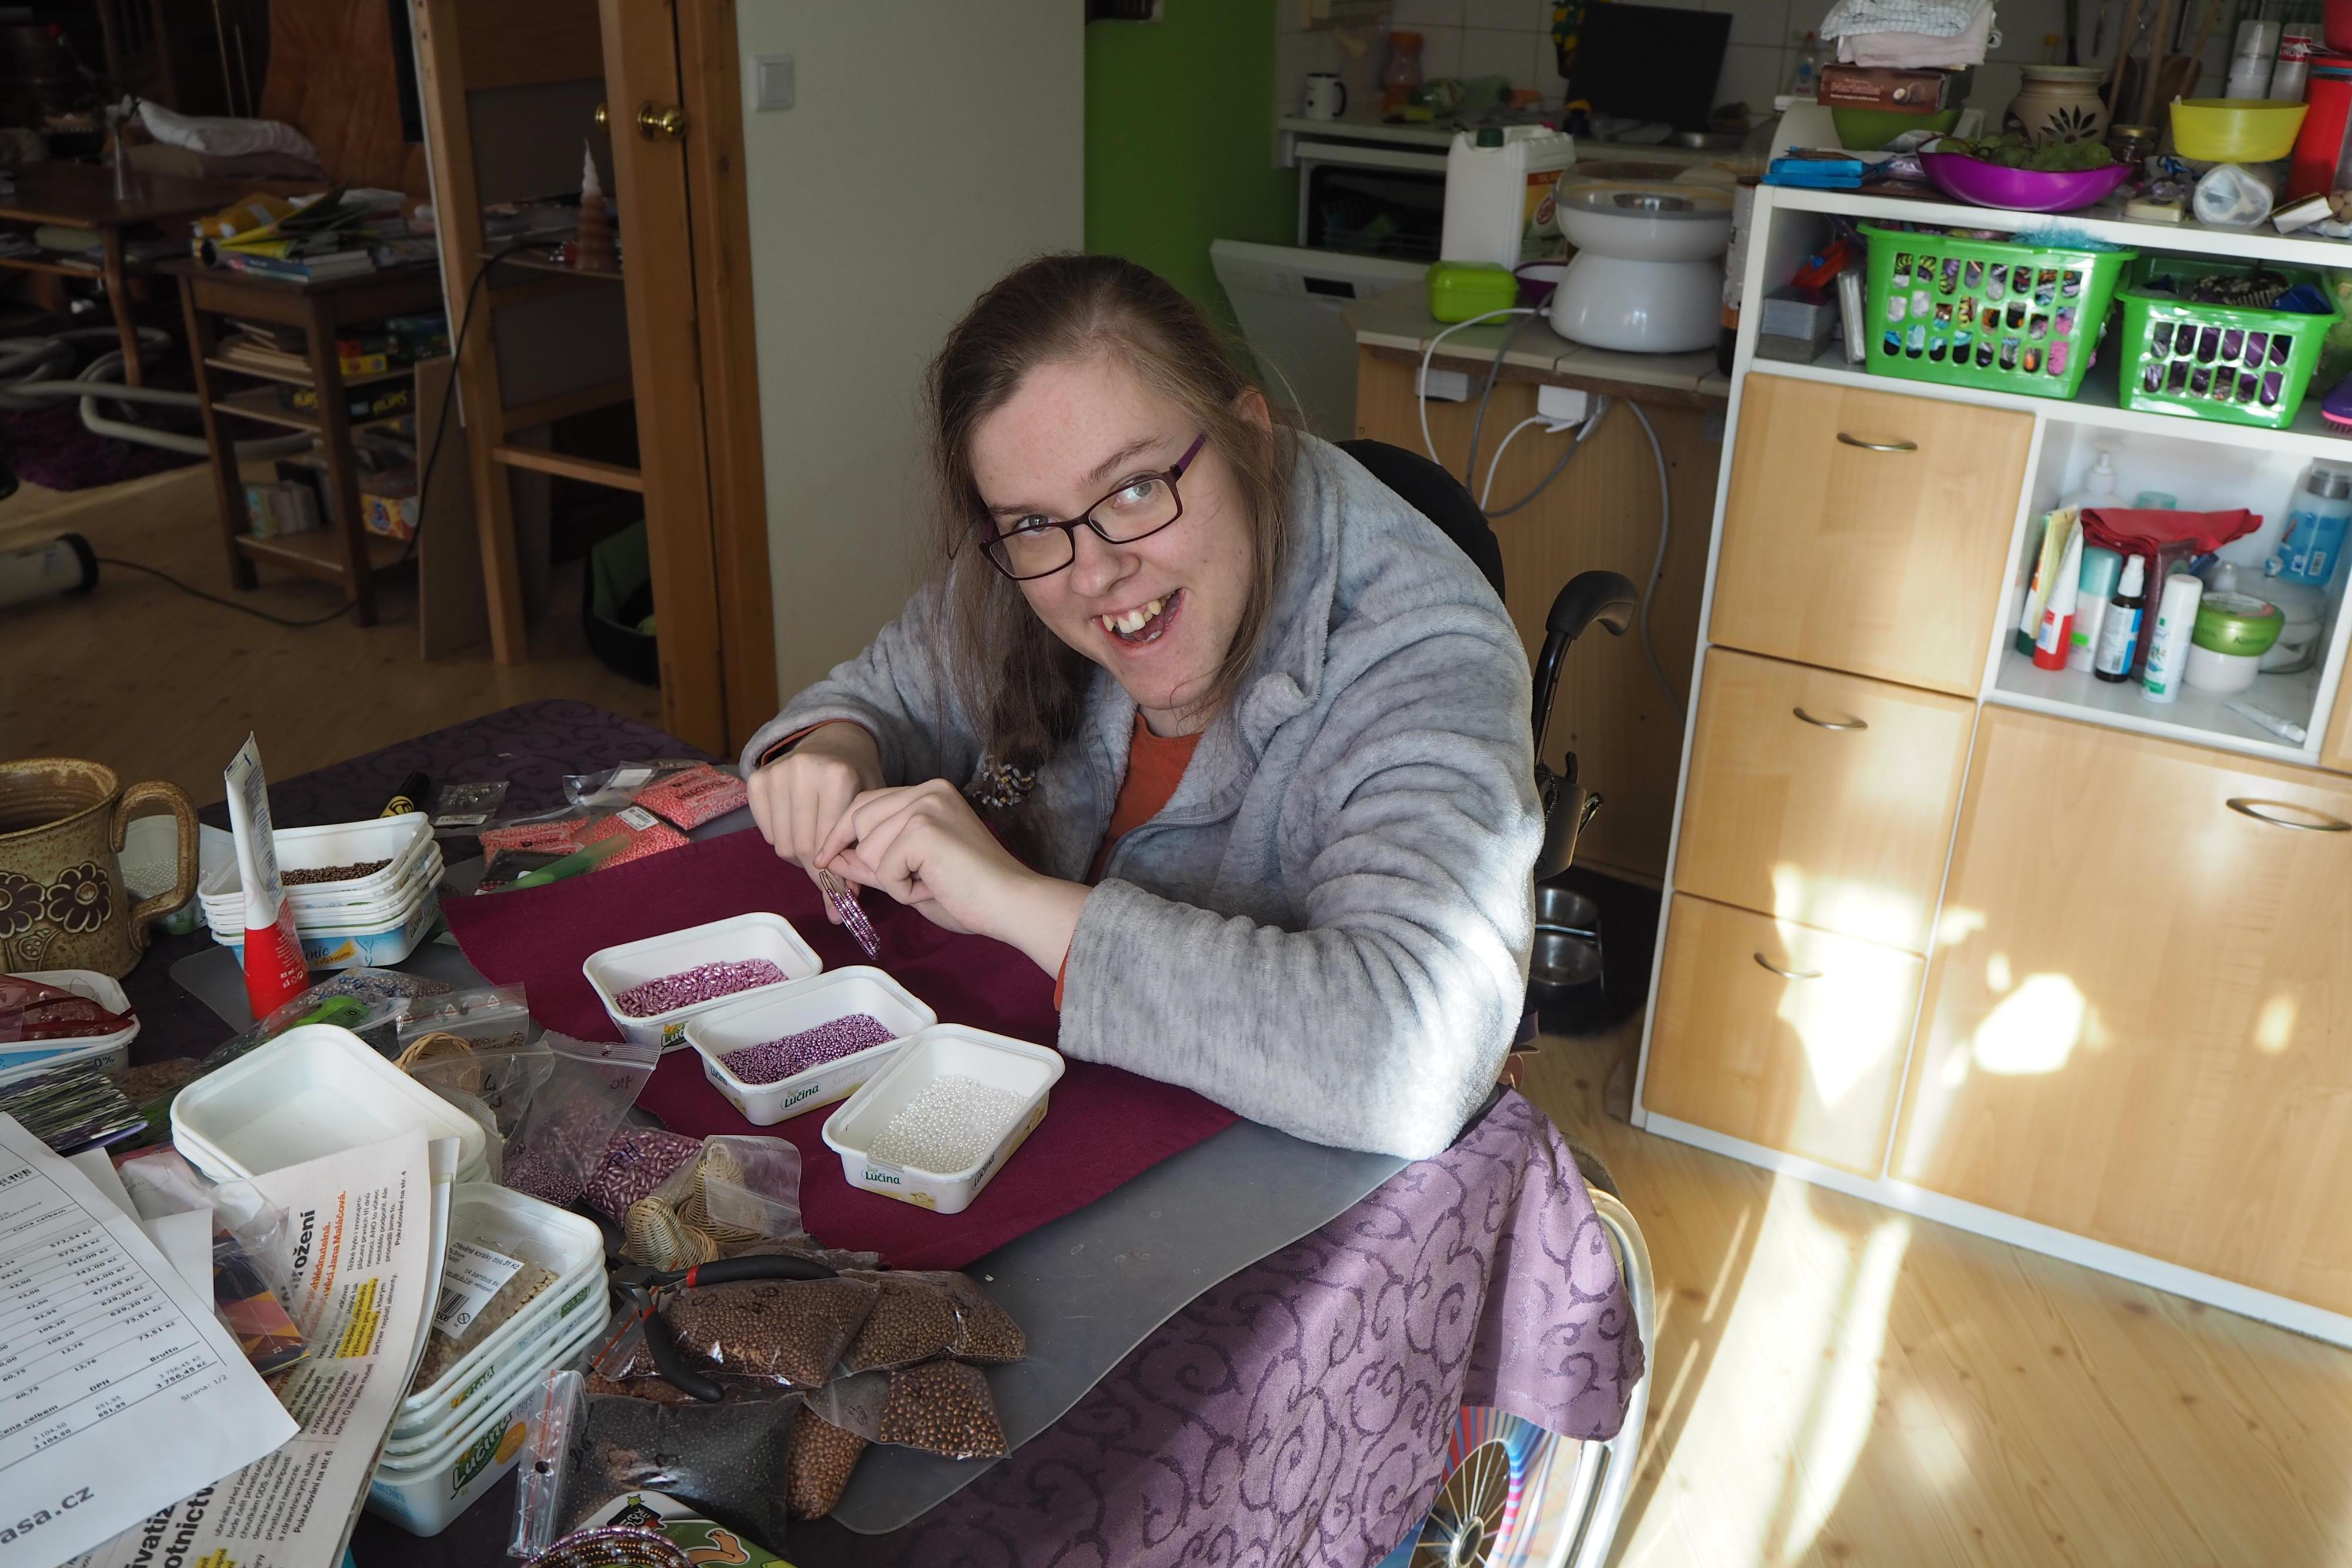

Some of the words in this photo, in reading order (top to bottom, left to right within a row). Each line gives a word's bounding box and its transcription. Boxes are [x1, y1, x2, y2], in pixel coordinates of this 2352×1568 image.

[784, 1084, 820, 1109] Lučina
[865, 1170, 901, 1185] Lučina
[333, 1190, 346, 1245] Maláčová.
[395, 1200, 404, 1246] Pokračování
[50, 1233, 81, 1248] 573,54
[58, 1243, 89, 1258] 573,54
[327, 1243, 339, 1271] Jana
[67, 1253, 98, 1267] 242,00
[76, 1262, 106, 1276] 242,00
[84, 1271, 115, 1286] 242,00
[323, 1273, 334, 1296] věci
[471, 1272, 493, 1284] bambus
[92, 1281, 123, 1296] 477,95
[101, 1290, 132, 1306] 629,20
[110, 1300, 141, 1317] 629,20
[125, 1310, 151, 1326] 73,51
[138, 1326, 163, 1342] 73,51
[89, 1379, 111, 1393] DPH
[149, 1345, 179, 1363] Brutto
[165, 1366, 195, 1386] 756,45
[196, 1360, 208, 1369] Kč
[181, 1384, 209, 1402] Strana:
[213, 1374, 228, 1386] 1/2
[294, 1482, 320, 1533] Pokračování
[320, 1457, 330, 1469] str.
[1, 1486, 95, 1544] asa.cz
[164, 1479, 219, 1568] otnictv
